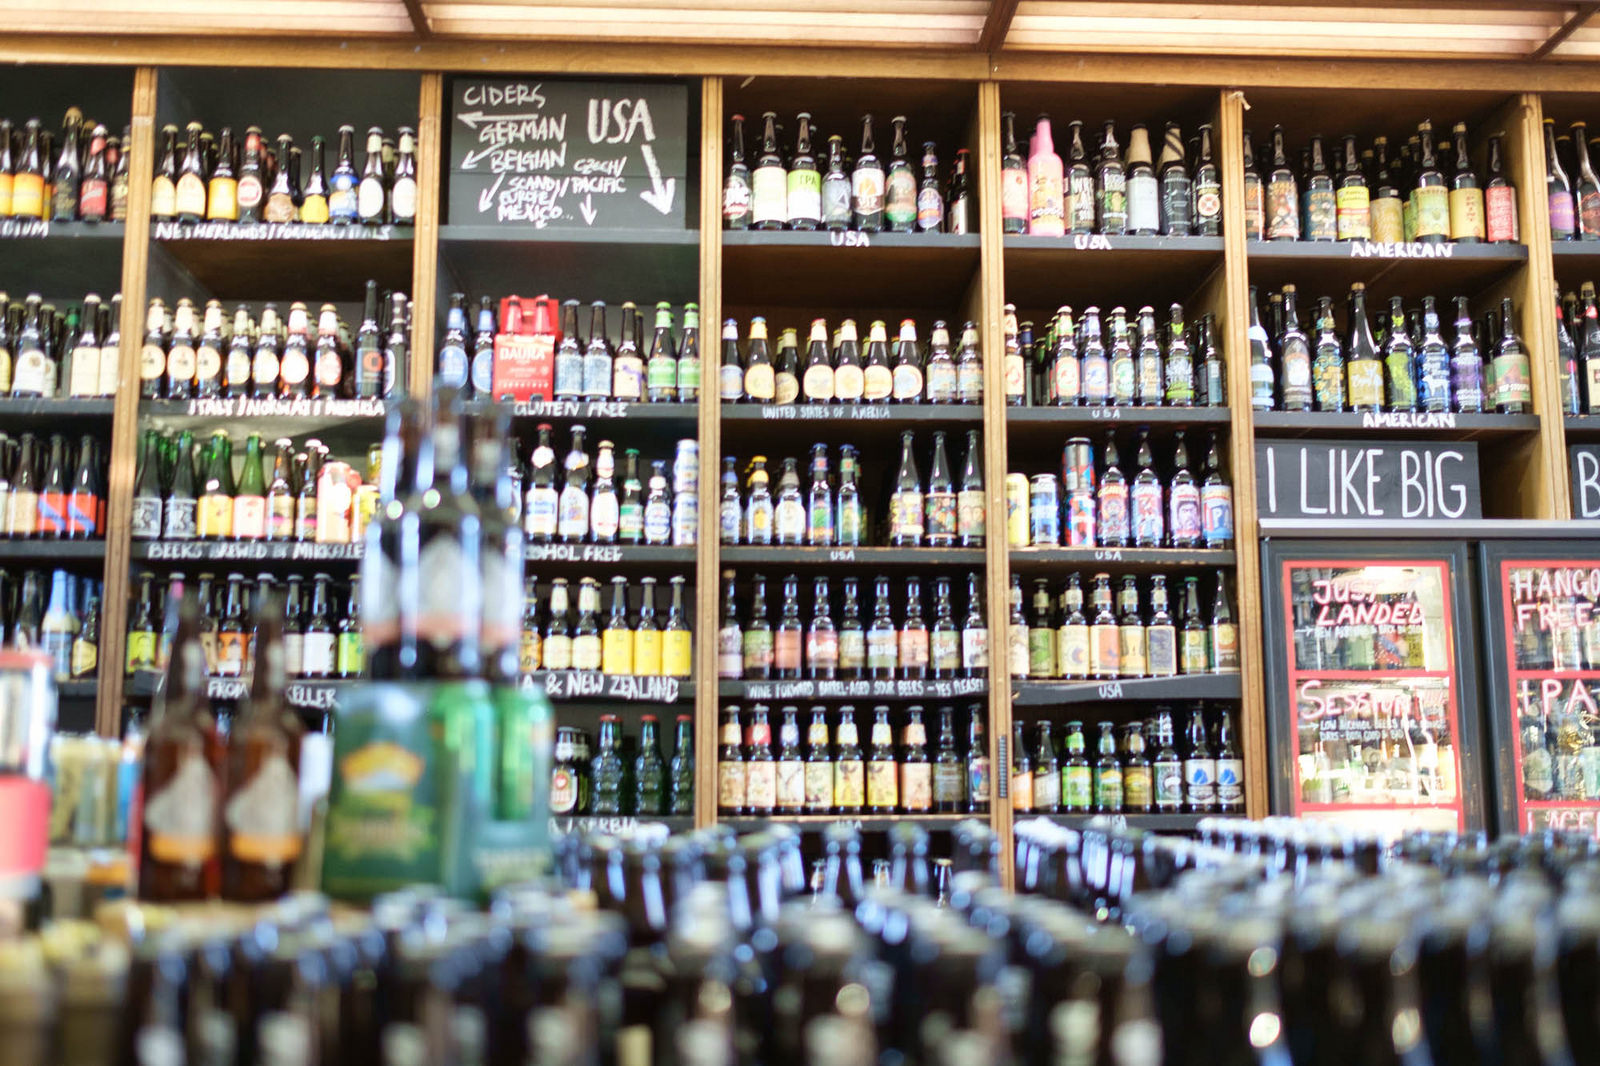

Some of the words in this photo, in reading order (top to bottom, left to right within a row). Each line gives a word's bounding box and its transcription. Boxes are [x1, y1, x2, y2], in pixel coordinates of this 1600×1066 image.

[464, 84, 546, 109] CIDERS
[479, 113, 567, 145] GERMAN
[587, 98, 656, 144] USA
[490, 141, 567, 174] BELGIAN
[571, 176, 627, 194] PACIFIC
[830, 231, 871, 247] USA
[1350, 240, 1455, 258] AMERICAN
[514, 402, 580, 417] GLUTEN
[587, 402, 629, 418] FREE
[762, 405, 796, 419] UNITED
[800, 405, 829, 418] STATES
[833, 406, 844, 418] OF
[851, 406, 891, 419] AMERICA
[1092, 409, 1120, 419] USA
[1363, 411, 1456, 429] AMERICAN
[1266, 447, 1277, 513] I
[1300, 447, 1384, 516] LIKE
[1400, 449, 1467, 518] BIG
[584, 544, 624, 562] FREE
[830, 550, 855, 561] USA
[1095, 551, 1123, 561] USA
[1312, 580, 1378, 605] JUST
[1316, 603, 1424, 626] LANDED
[1516, 602, 1594, 632] FREE
[545, 673, 562, 695] &
[566, 672, 604, 696] NEW
[609, 675, 679, 703] ZEALAND
[1098, 684, 1123, 698] USA
[1520, 679, 1599, 715] IPA
